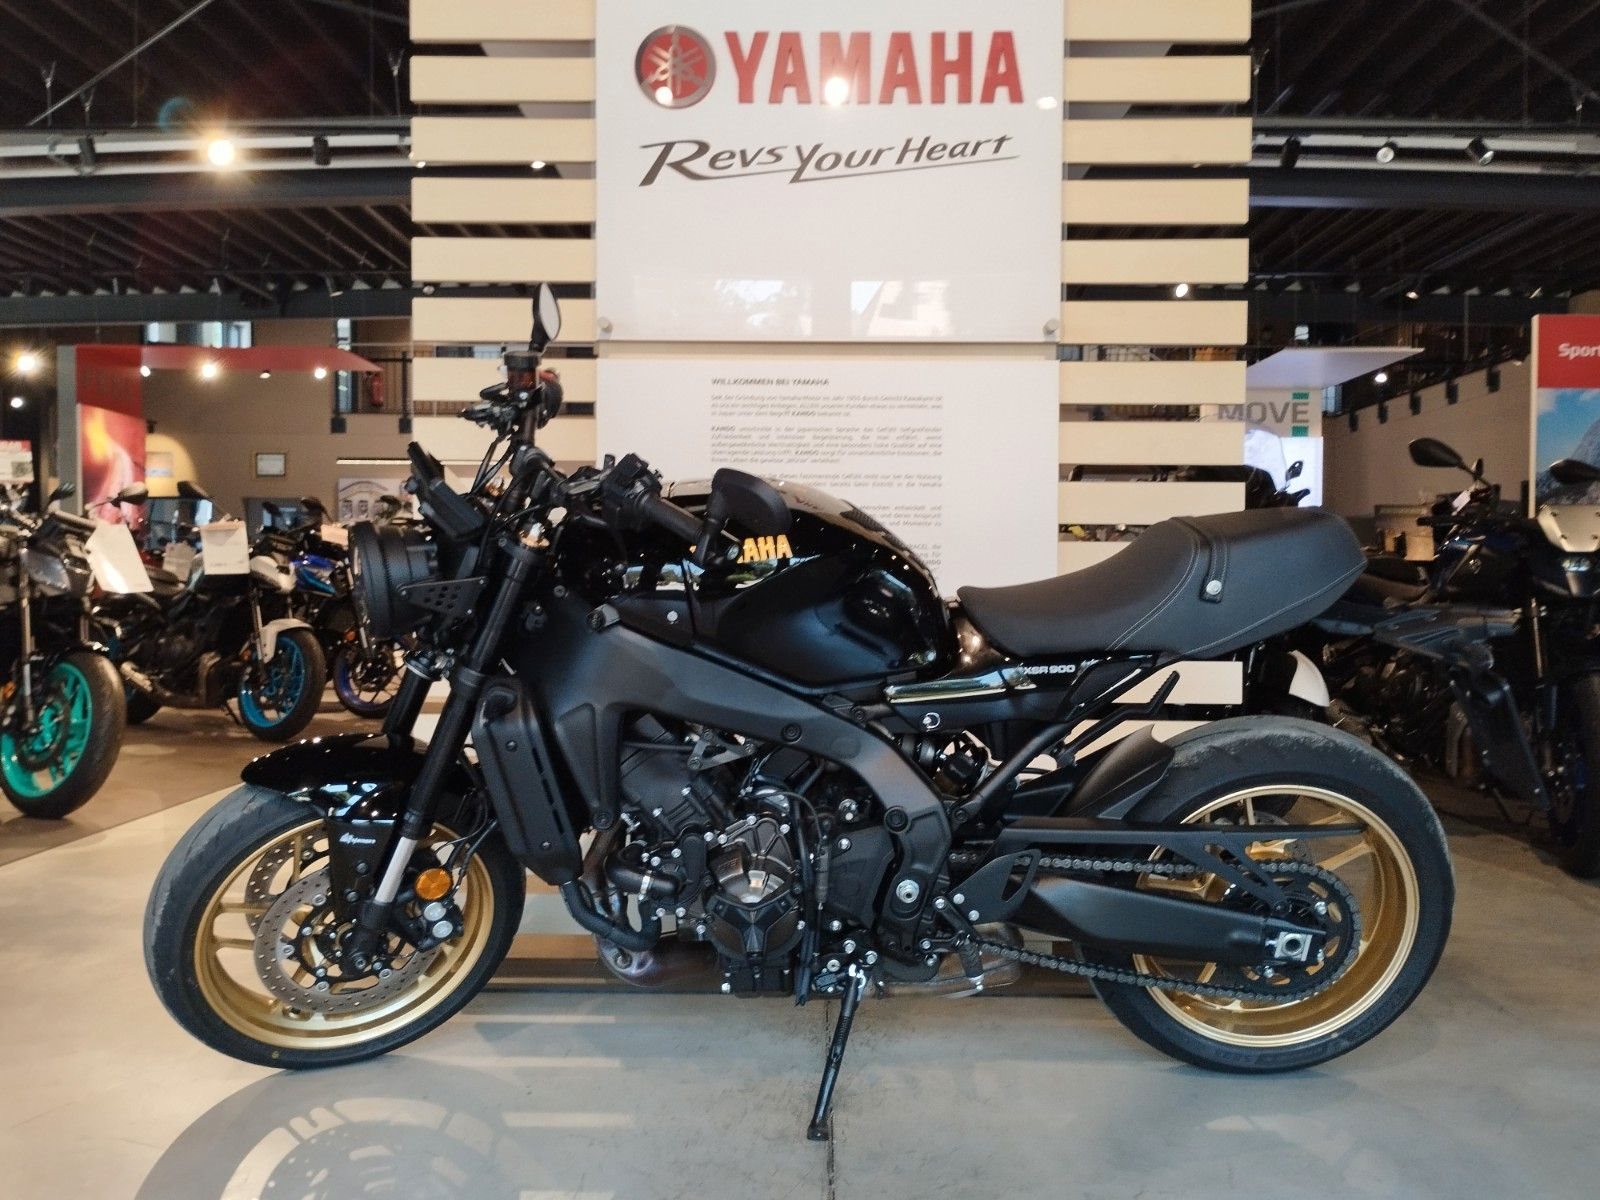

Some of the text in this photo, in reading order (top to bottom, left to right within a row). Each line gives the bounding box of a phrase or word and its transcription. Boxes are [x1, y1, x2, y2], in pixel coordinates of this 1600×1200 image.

[724, 31, 1023, 104] YAMAHA
[639, 134, 1013, 187] Revs Your Heart
[1217, 402, 1310, 424] MOVE
[1049, 664, 1076, 674] 900
